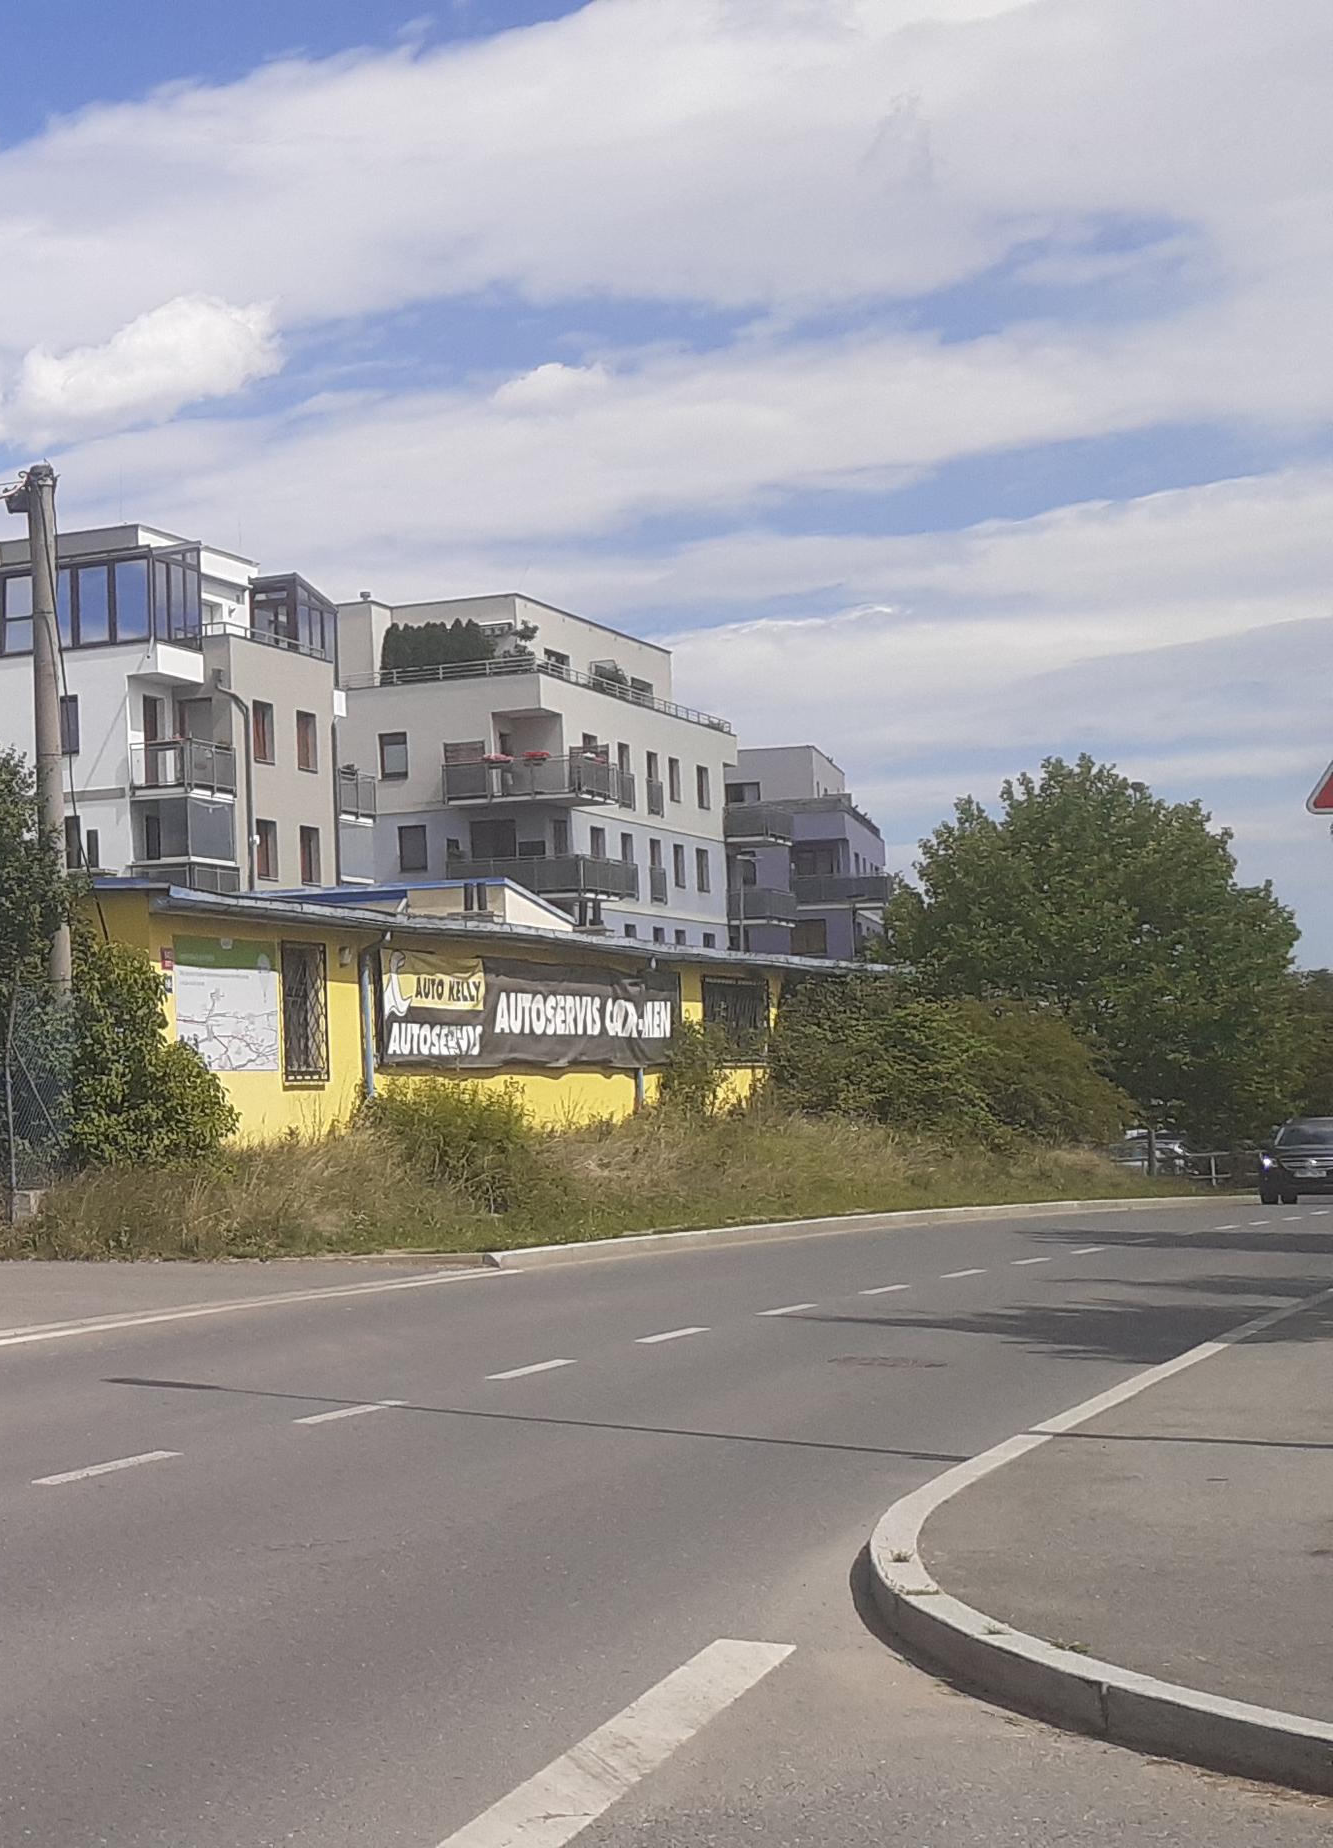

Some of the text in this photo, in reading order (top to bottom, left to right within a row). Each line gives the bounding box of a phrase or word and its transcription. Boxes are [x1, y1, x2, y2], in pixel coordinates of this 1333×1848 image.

[415, 977, 482, 1002] AUTO KELLY
[493, 992, 602, 1036] AUTOSERVIS
[387, 1022, 483, 1056] AUTOSERVIS
